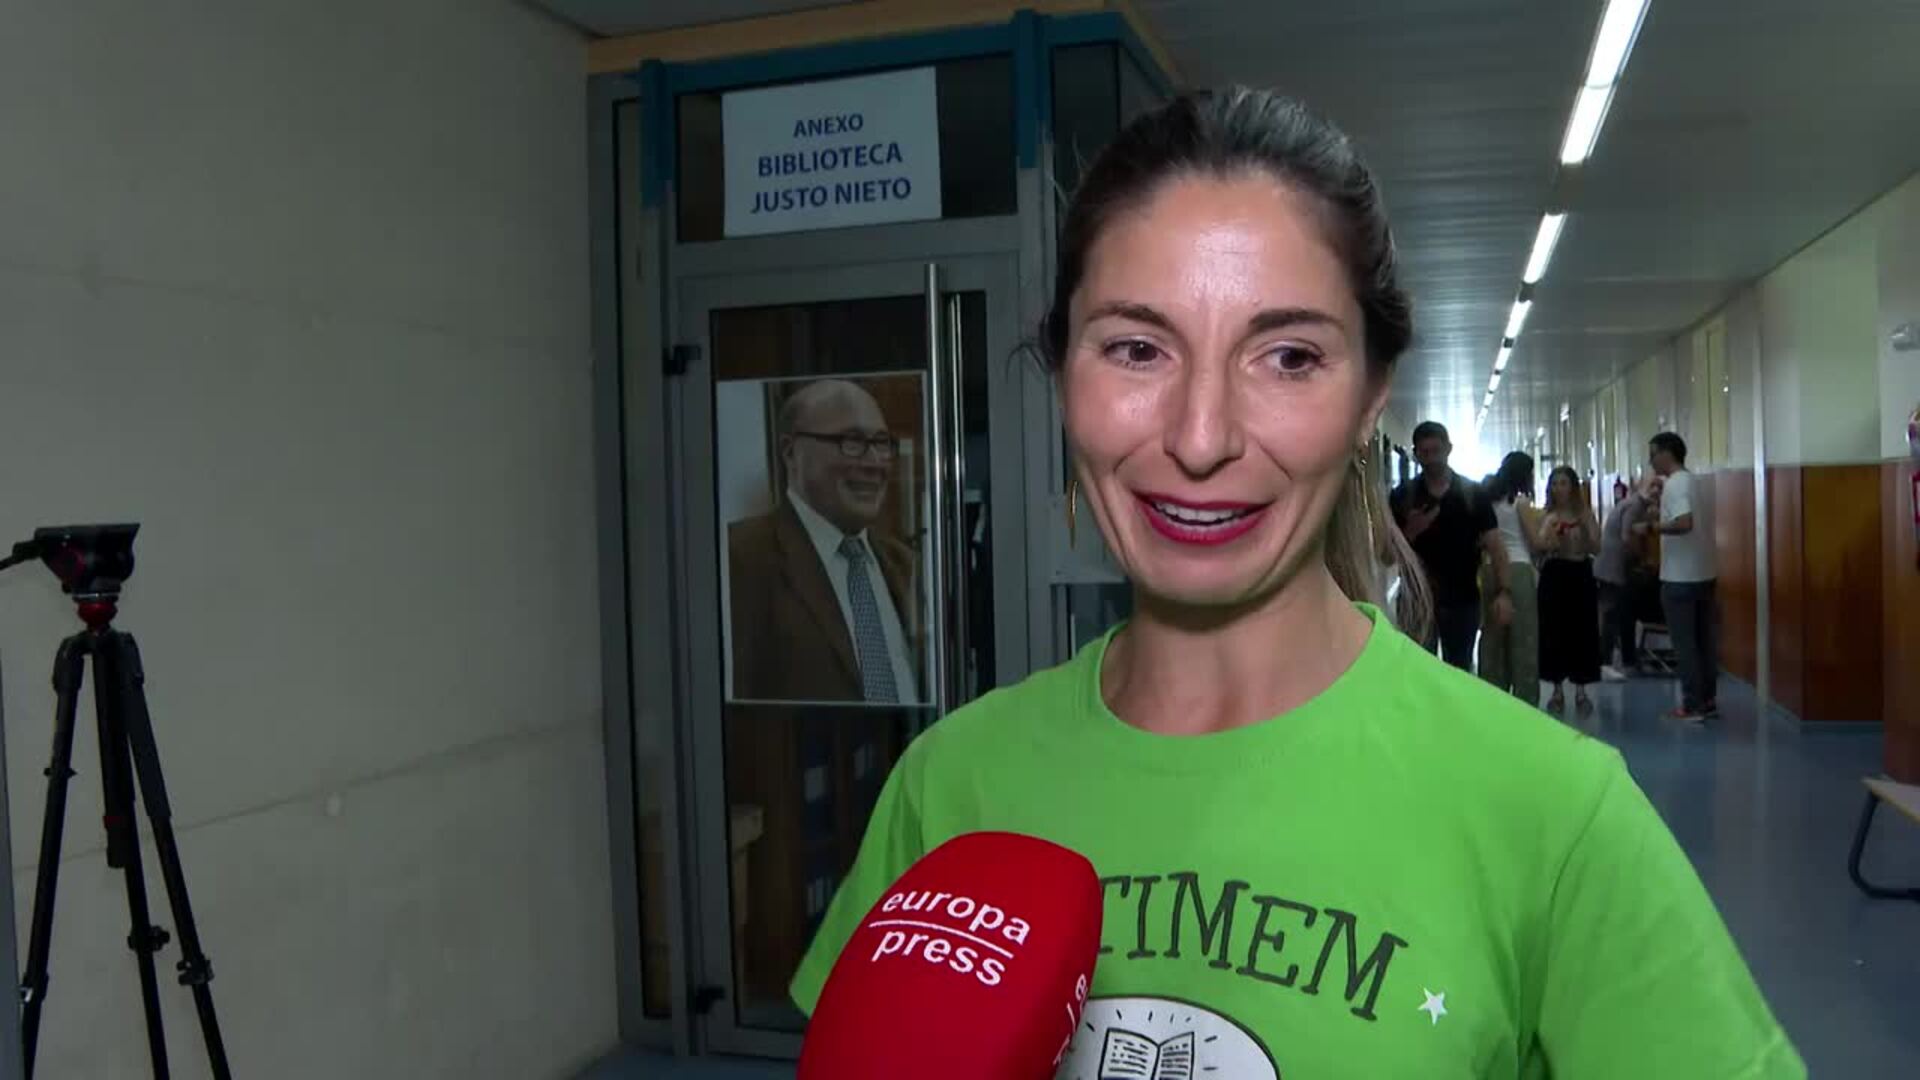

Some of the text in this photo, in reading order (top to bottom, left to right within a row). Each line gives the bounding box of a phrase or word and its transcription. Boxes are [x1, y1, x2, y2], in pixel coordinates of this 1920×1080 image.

[793, 113, 863, 138] ANEXO
[757, 141, 903, 178] BIBLIOTECA
[750, 177, 911, 214] JUSTO NIETO
[882, 890, 1031, 946] europa
[871, 930, 1006, 986] press
